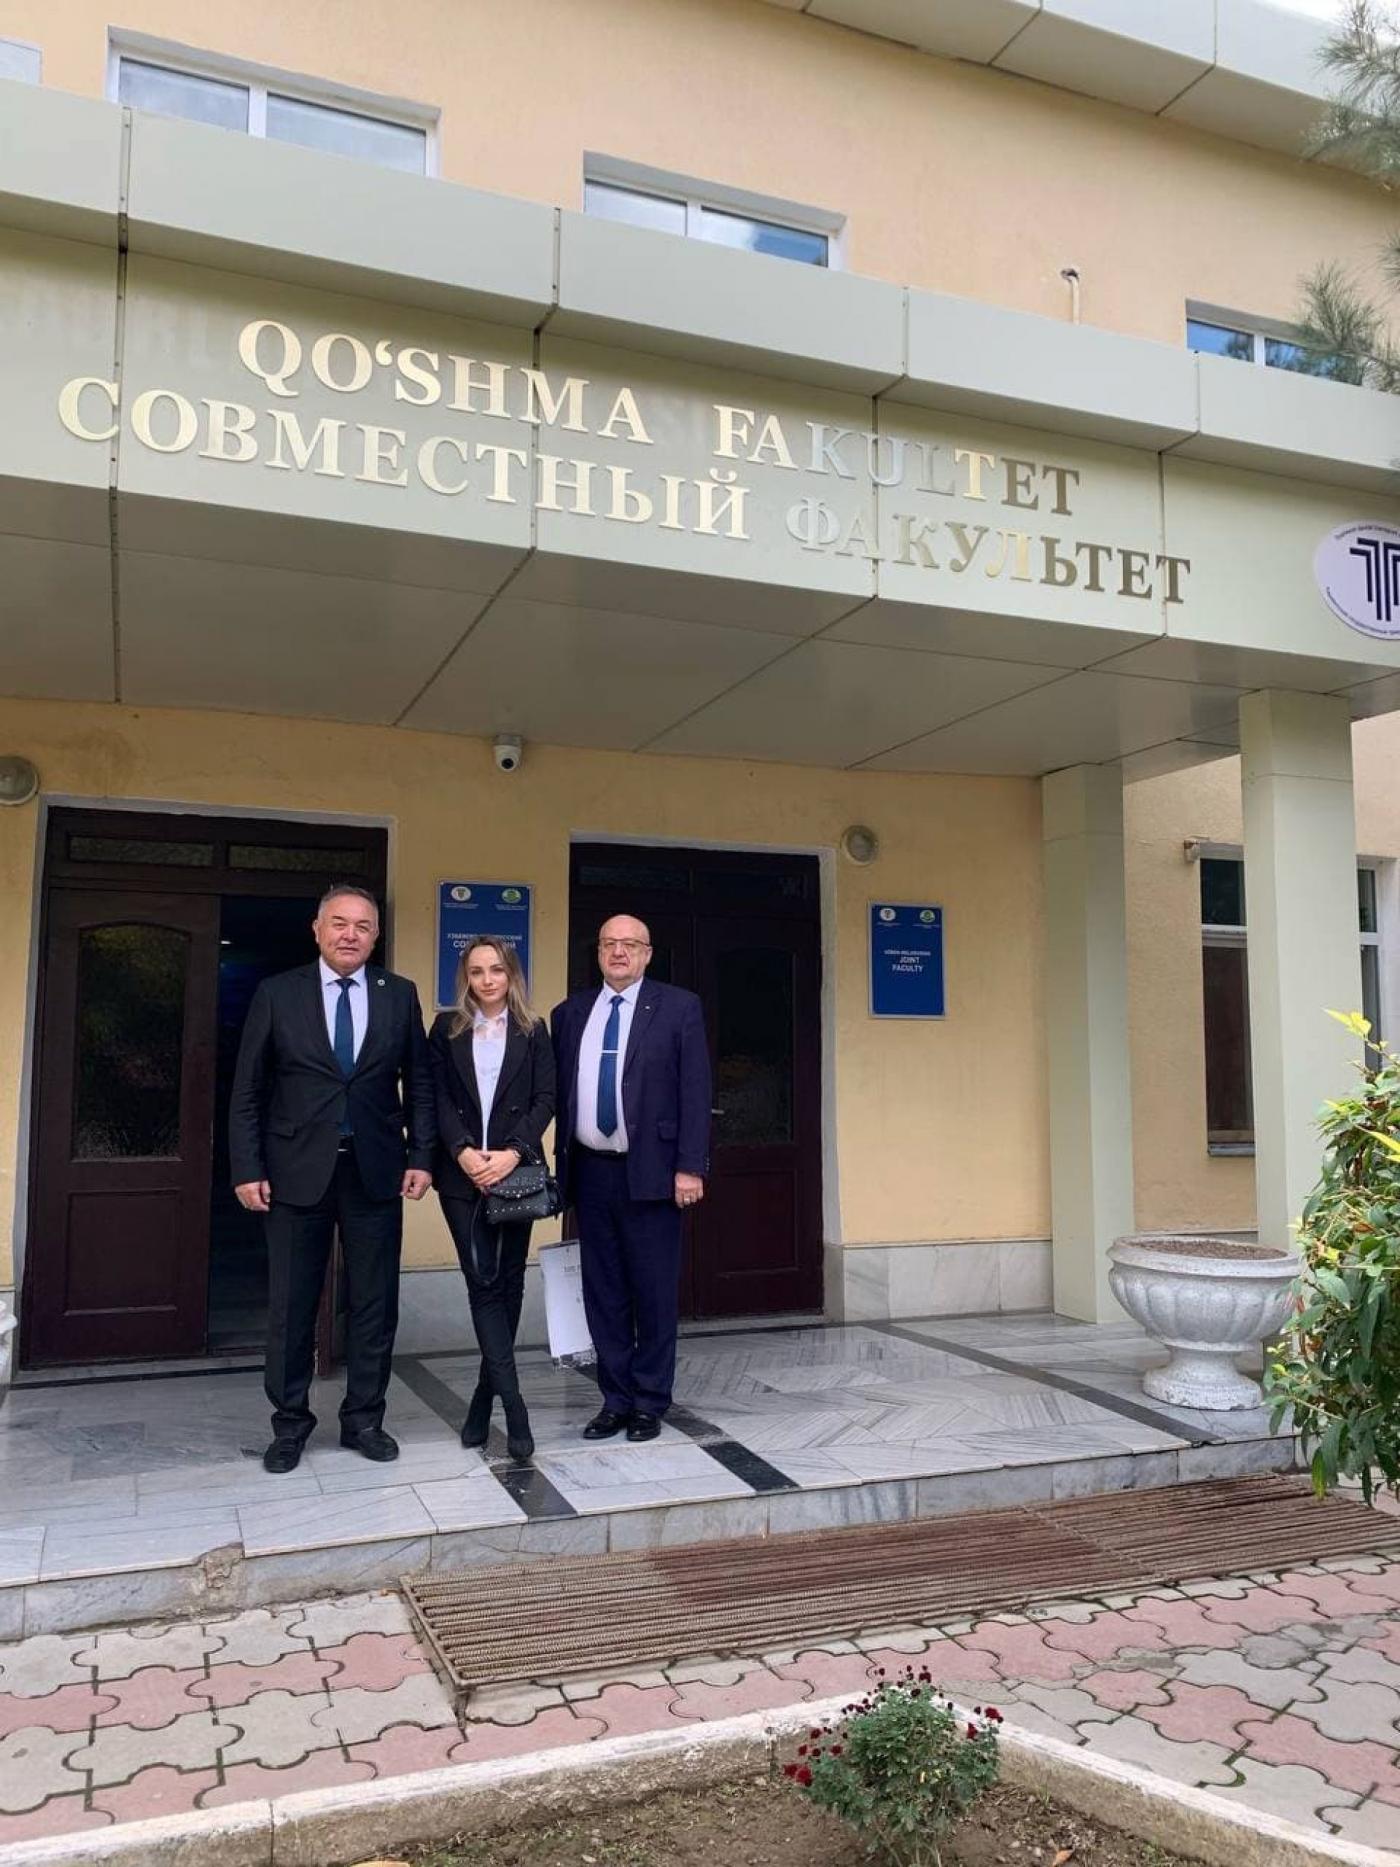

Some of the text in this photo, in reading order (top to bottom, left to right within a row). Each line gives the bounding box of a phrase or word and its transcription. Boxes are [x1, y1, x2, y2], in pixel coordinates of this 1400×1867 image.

[58, 377, 1190, 603] СОВМЕСТНЫЙ ФАКУЛЬТЕТ
[712, 404, 1080, 516] FAKULTET
[892, 964, 923, 972] FACULTY
